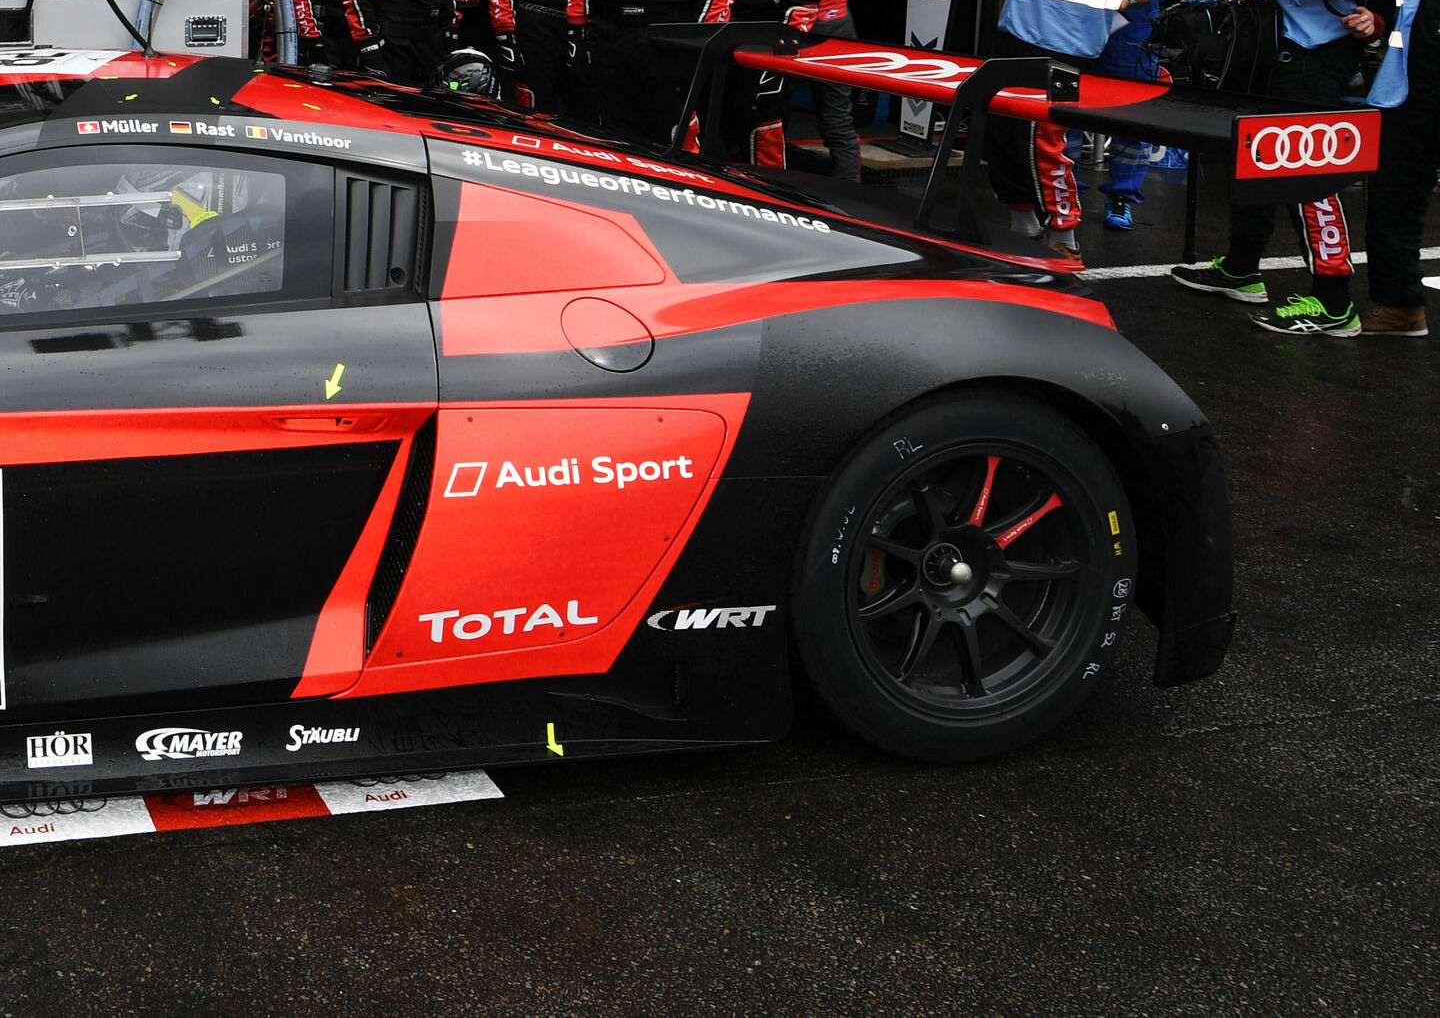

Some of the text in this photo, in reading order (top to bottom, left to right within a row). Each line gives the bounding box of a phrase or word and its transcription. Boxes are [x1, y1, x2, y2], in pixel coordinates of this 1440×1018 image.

[102, 120, 352, 149] Müller Rast Vanthoor
[553, 143, 716, 184] Audi Sport
[463, 149, 831, 234] #LeagueofPerformance
[1057, 164, 1074, 225] TOTAL
[1317, 196, 1344, 261] TOTA
[893, 437, 923, 460] RL
[496, 456, 693, 489] Audi Sport
[418, 600, 598, 643] TOTAL
[673, 604, 776, 630] WRT
[30, 731, 91, 758] HÖR
[169, 732, 243, 752] MAYER
[286, 723, 360, 752] STÄUBLI
[196, 748, 241, 758] MOTORSPORT
[363, 789, 408, 804] Audi
[9, 822, 56, 836] Audi
